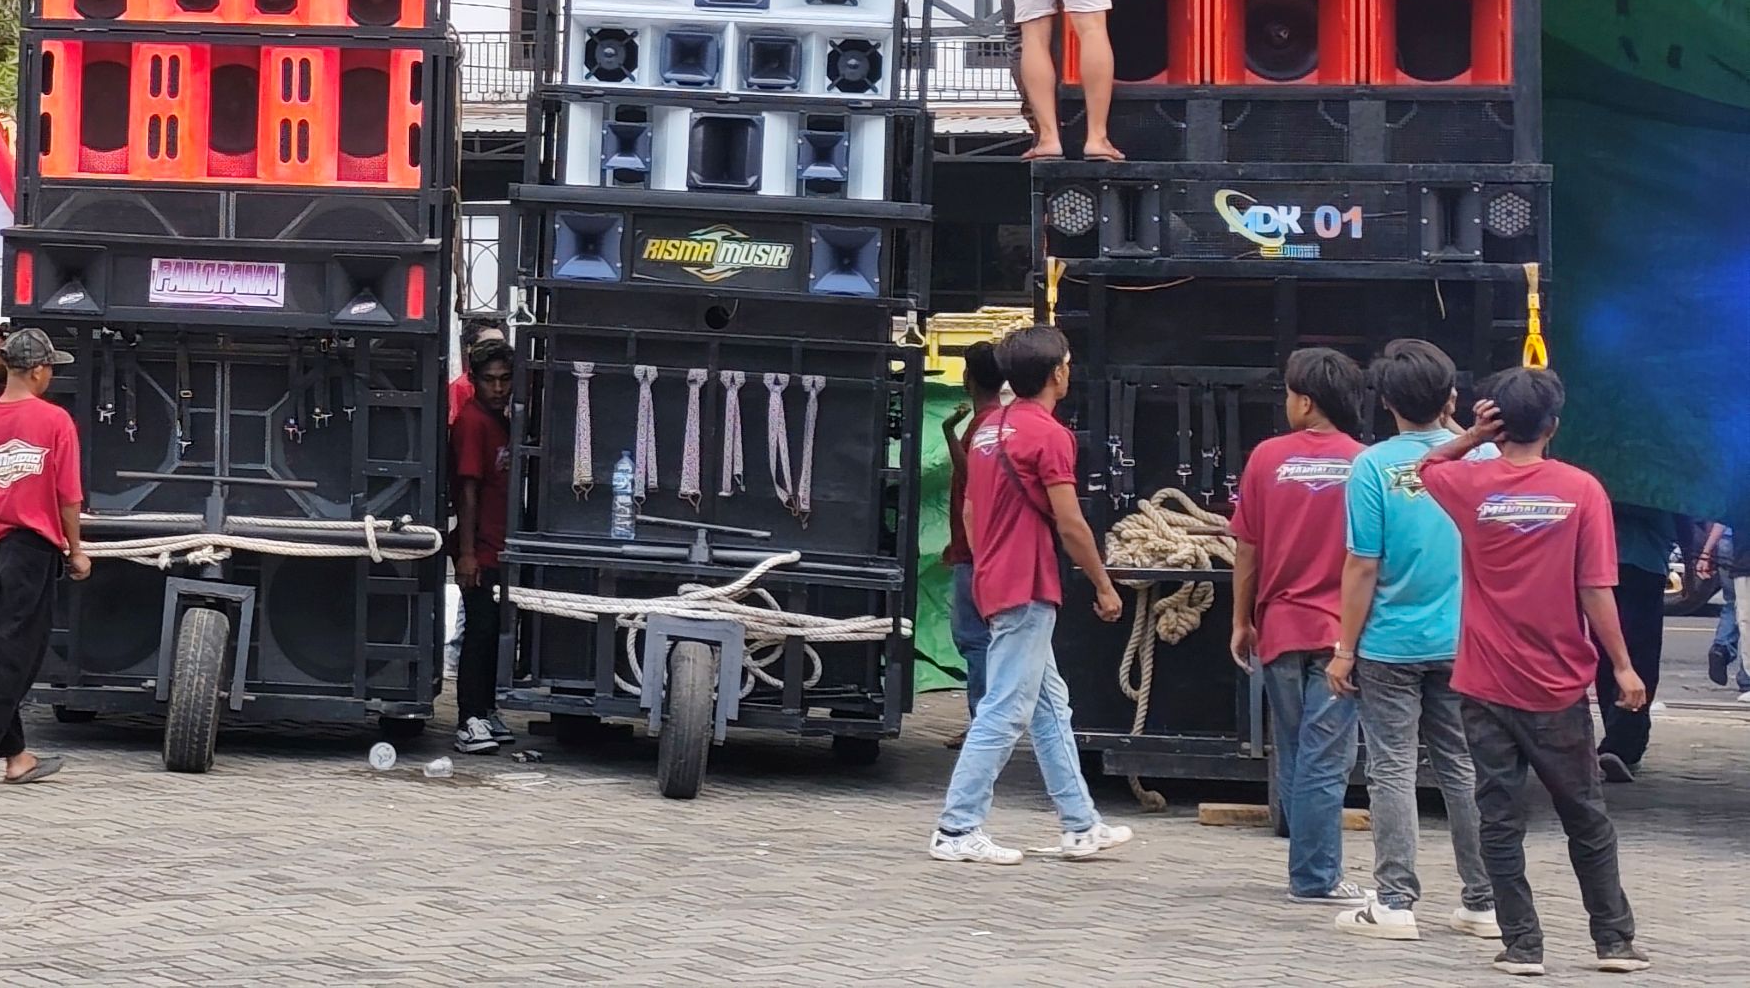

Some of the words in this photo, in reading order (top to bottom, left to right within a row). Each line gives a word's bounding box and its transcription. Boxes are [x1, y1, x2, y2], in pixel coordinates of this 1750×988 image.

[1228, 205, 1304, 234] MDK
[1314, 205, 1363, 239] 01
[642, 238, 717, 263] RISMA
[717, 241, 795, 268] MUSIK
[154, 260, 279, 297] PANORAMA
